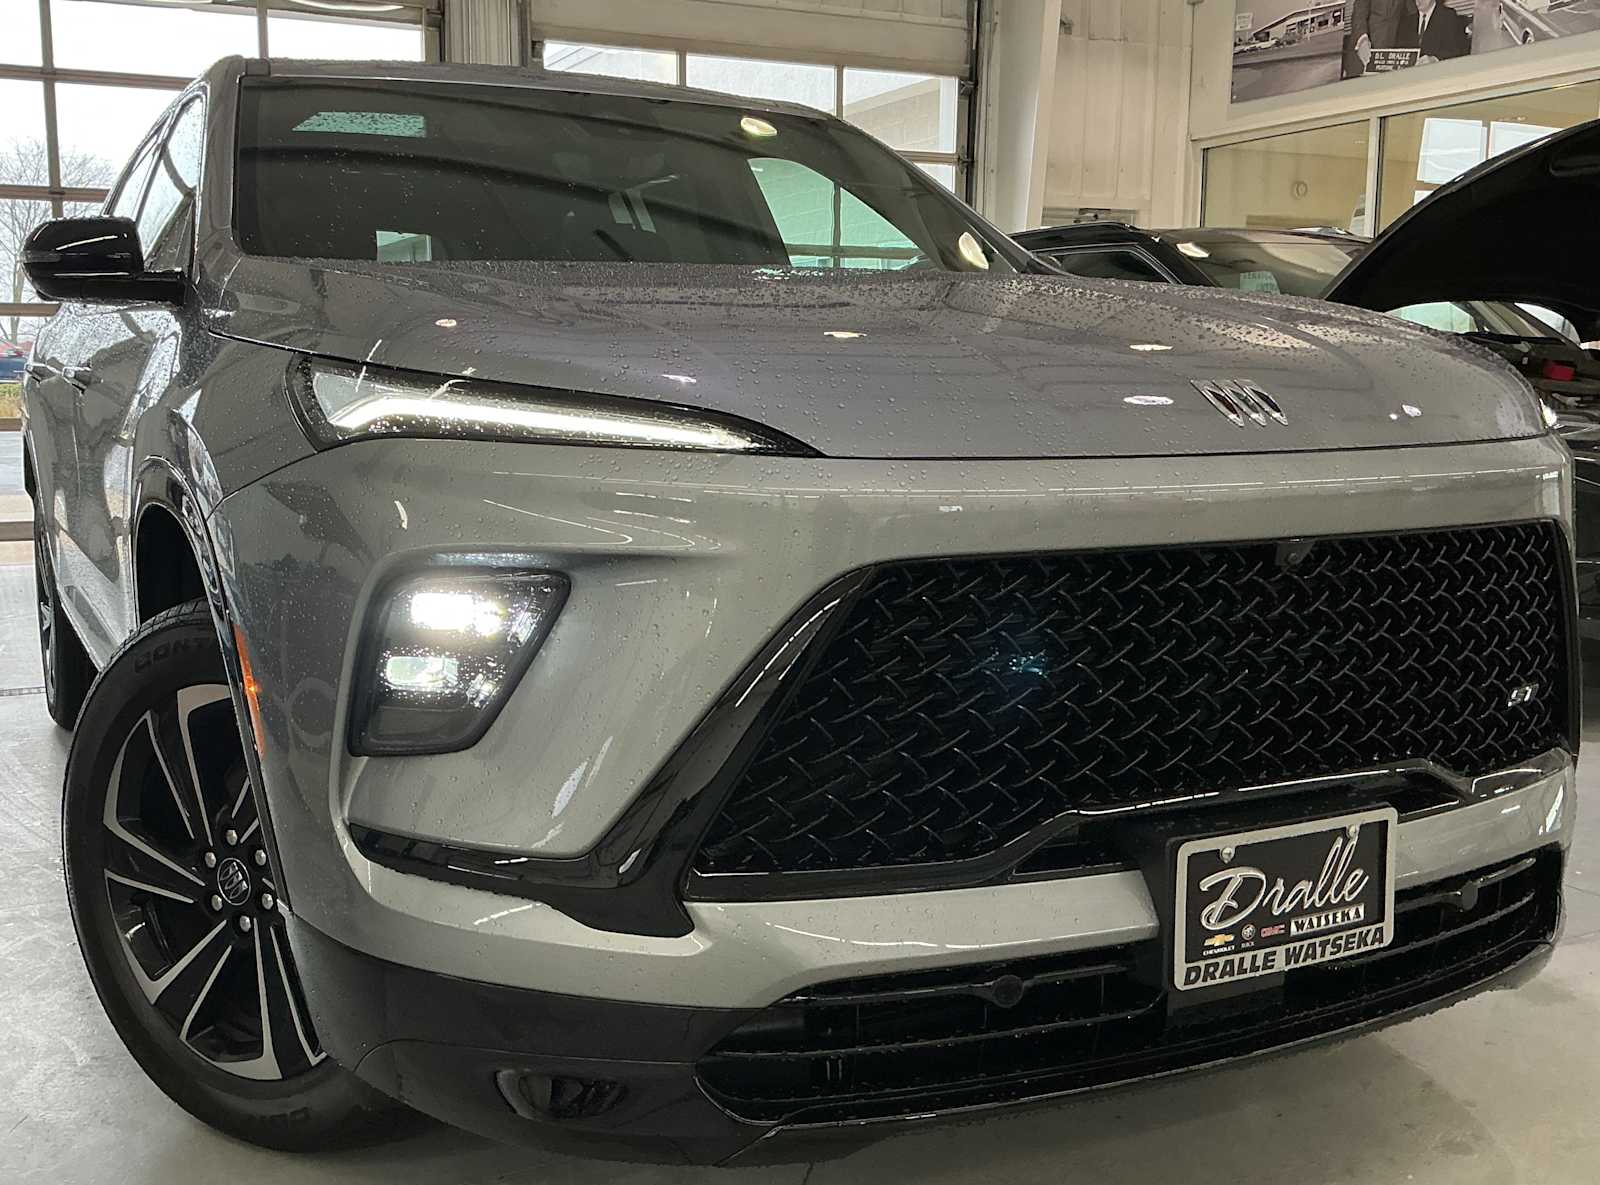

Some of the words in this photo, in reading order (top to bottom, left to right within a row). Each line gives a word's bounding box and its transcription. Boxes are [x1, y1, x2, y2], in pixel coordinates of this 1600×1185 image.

[1198, 835, 1370, 930] Dralle
[1293, 906, 1362, 933] WATSEKA
[1183, 950, 1277, 986] DRALLE
[1284, 926, 1384, 966] WATSEKA
